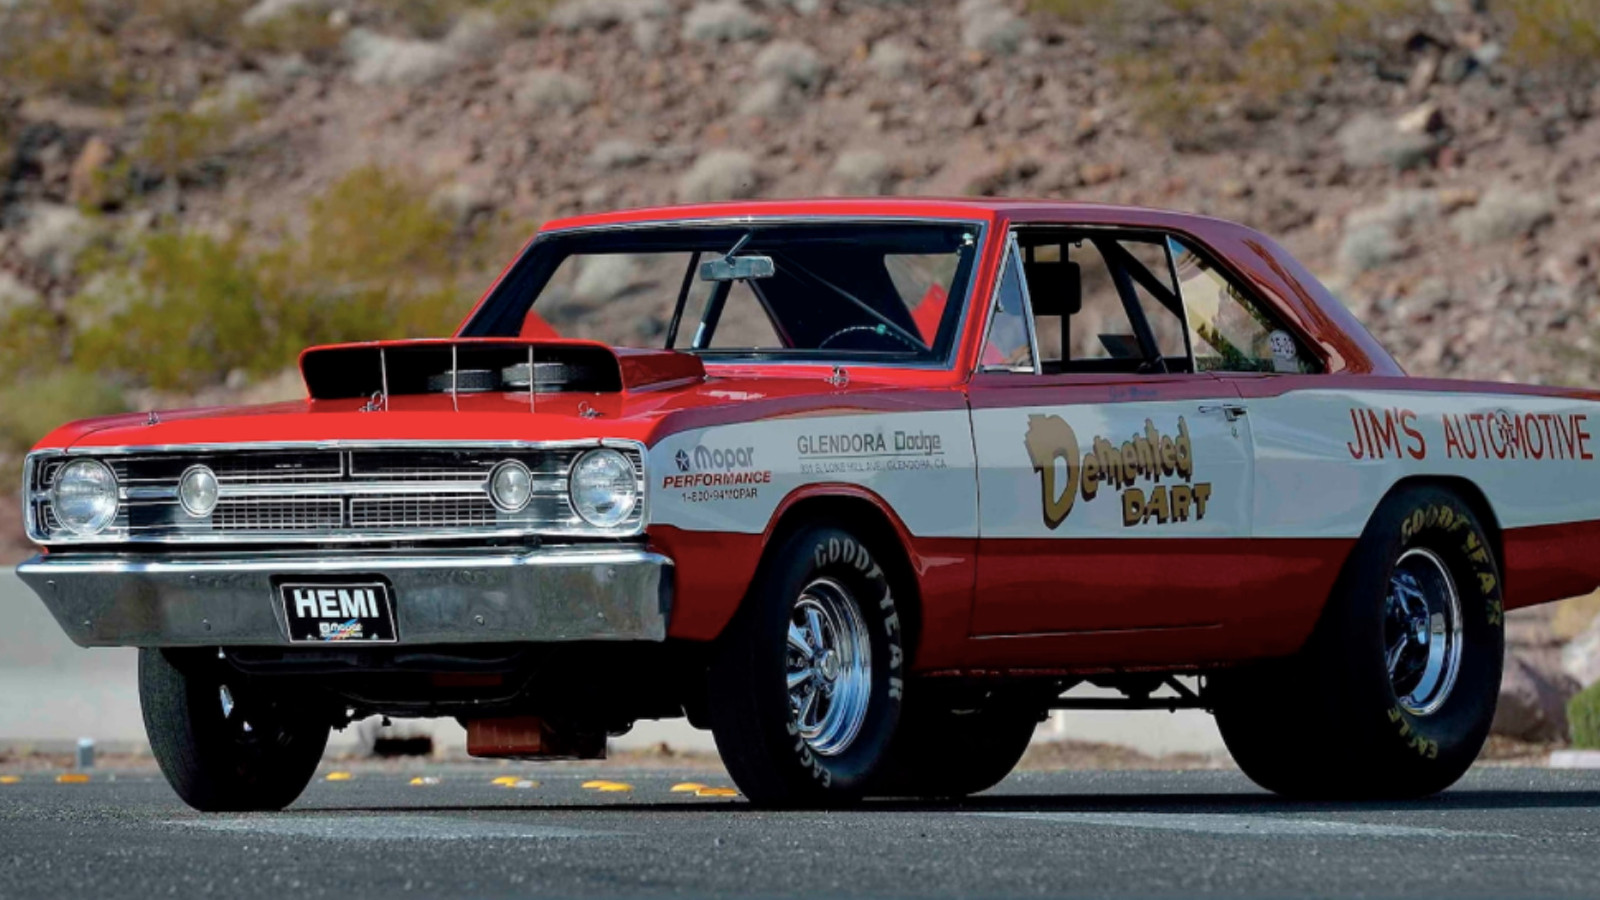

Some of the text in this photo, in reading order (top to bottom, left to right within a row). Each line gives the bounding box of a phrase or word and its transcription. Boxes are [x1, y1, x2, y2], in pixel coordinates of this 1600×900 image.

[797, 430, 942, 456] GLENDORA Dodge
[1347, 407, 1593, 460] JIM'S AUTOMOTIVE
[694, 444, 754, 472] Mopar
[1024, 413, 1193, 530] Demented
[663, 470, 772, 489] PERFORMANCE
[1121, 482, 1212, 527] DART
[293, 588, 380, 619] HEMI
[814, 537, 903, 701] GOODYEAR
